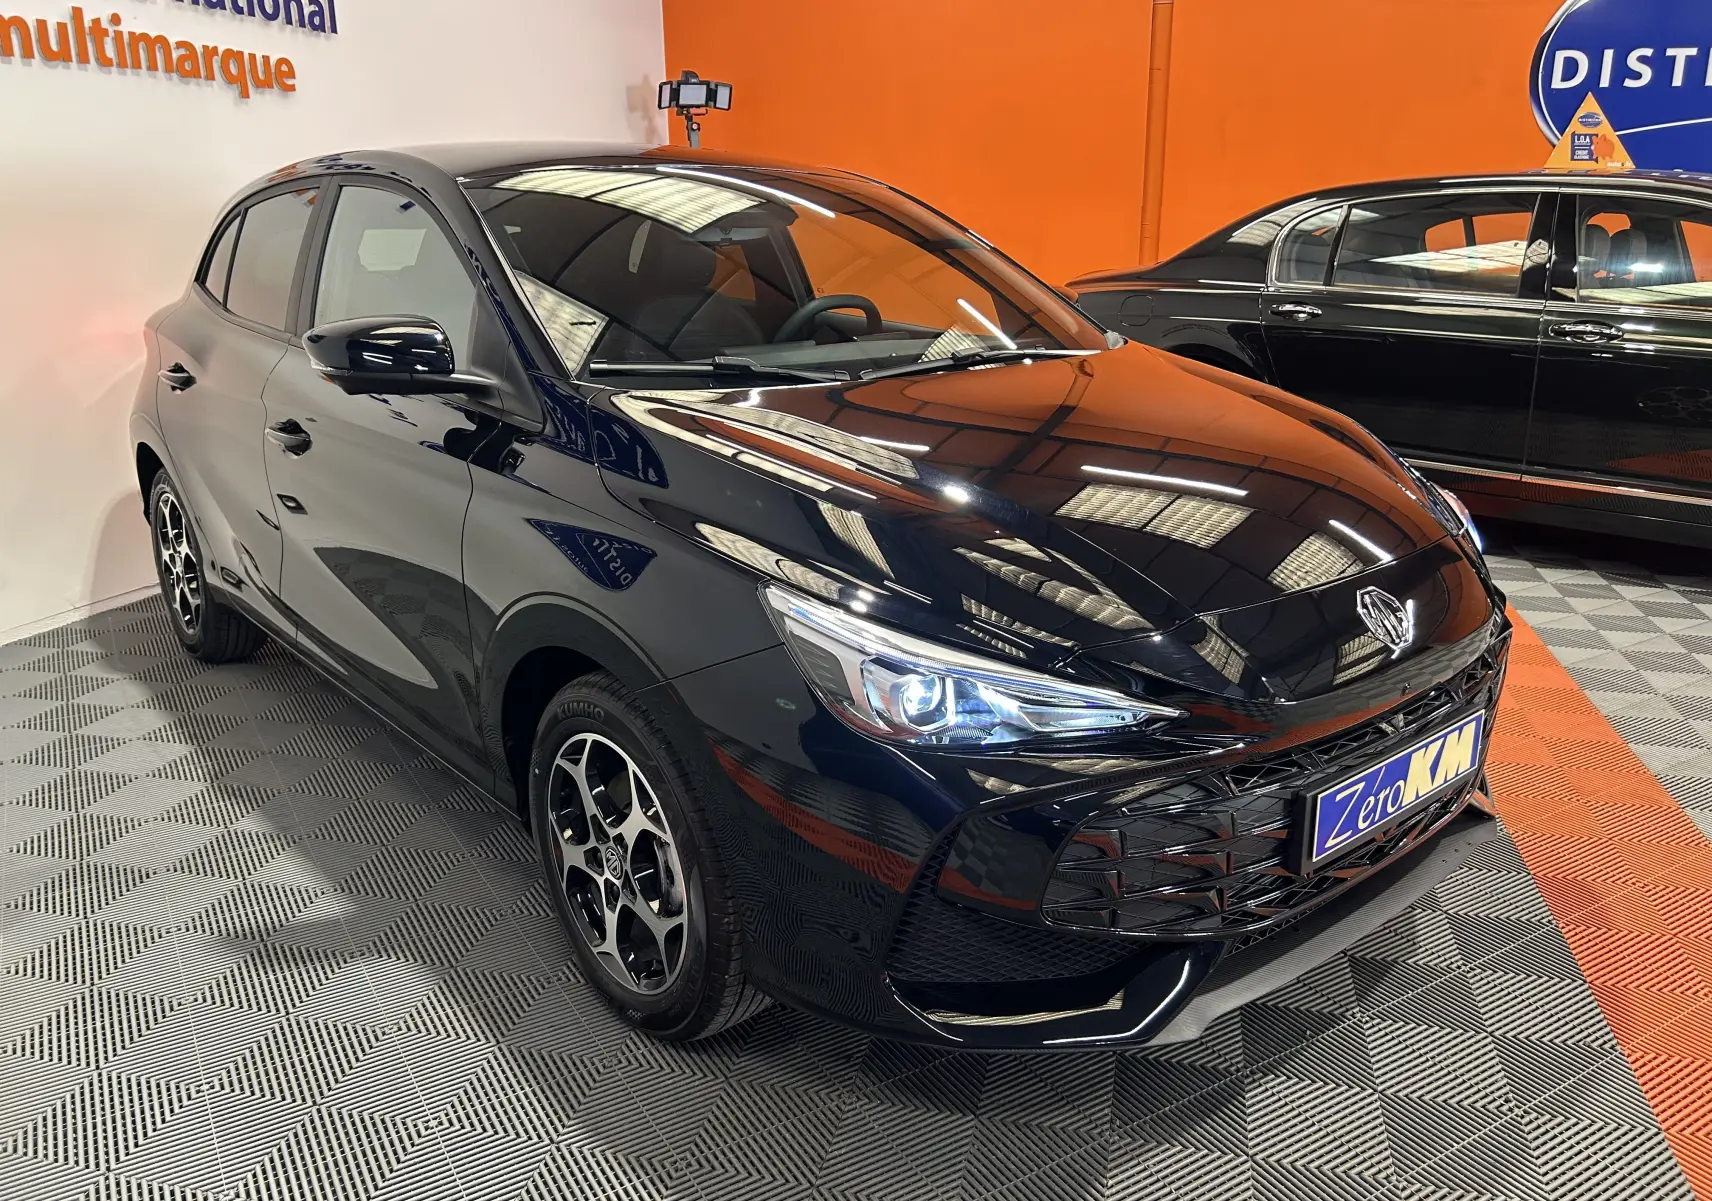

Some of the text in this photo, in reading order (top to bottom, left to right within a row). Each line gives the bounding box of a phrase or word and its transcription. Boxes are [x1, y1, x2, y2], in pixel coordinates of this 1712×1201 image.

[0, 5, 296, 99] multimarque
[1551, 48, 1712, 89] DIST
[556, 701, 605, 723] KUMHO
